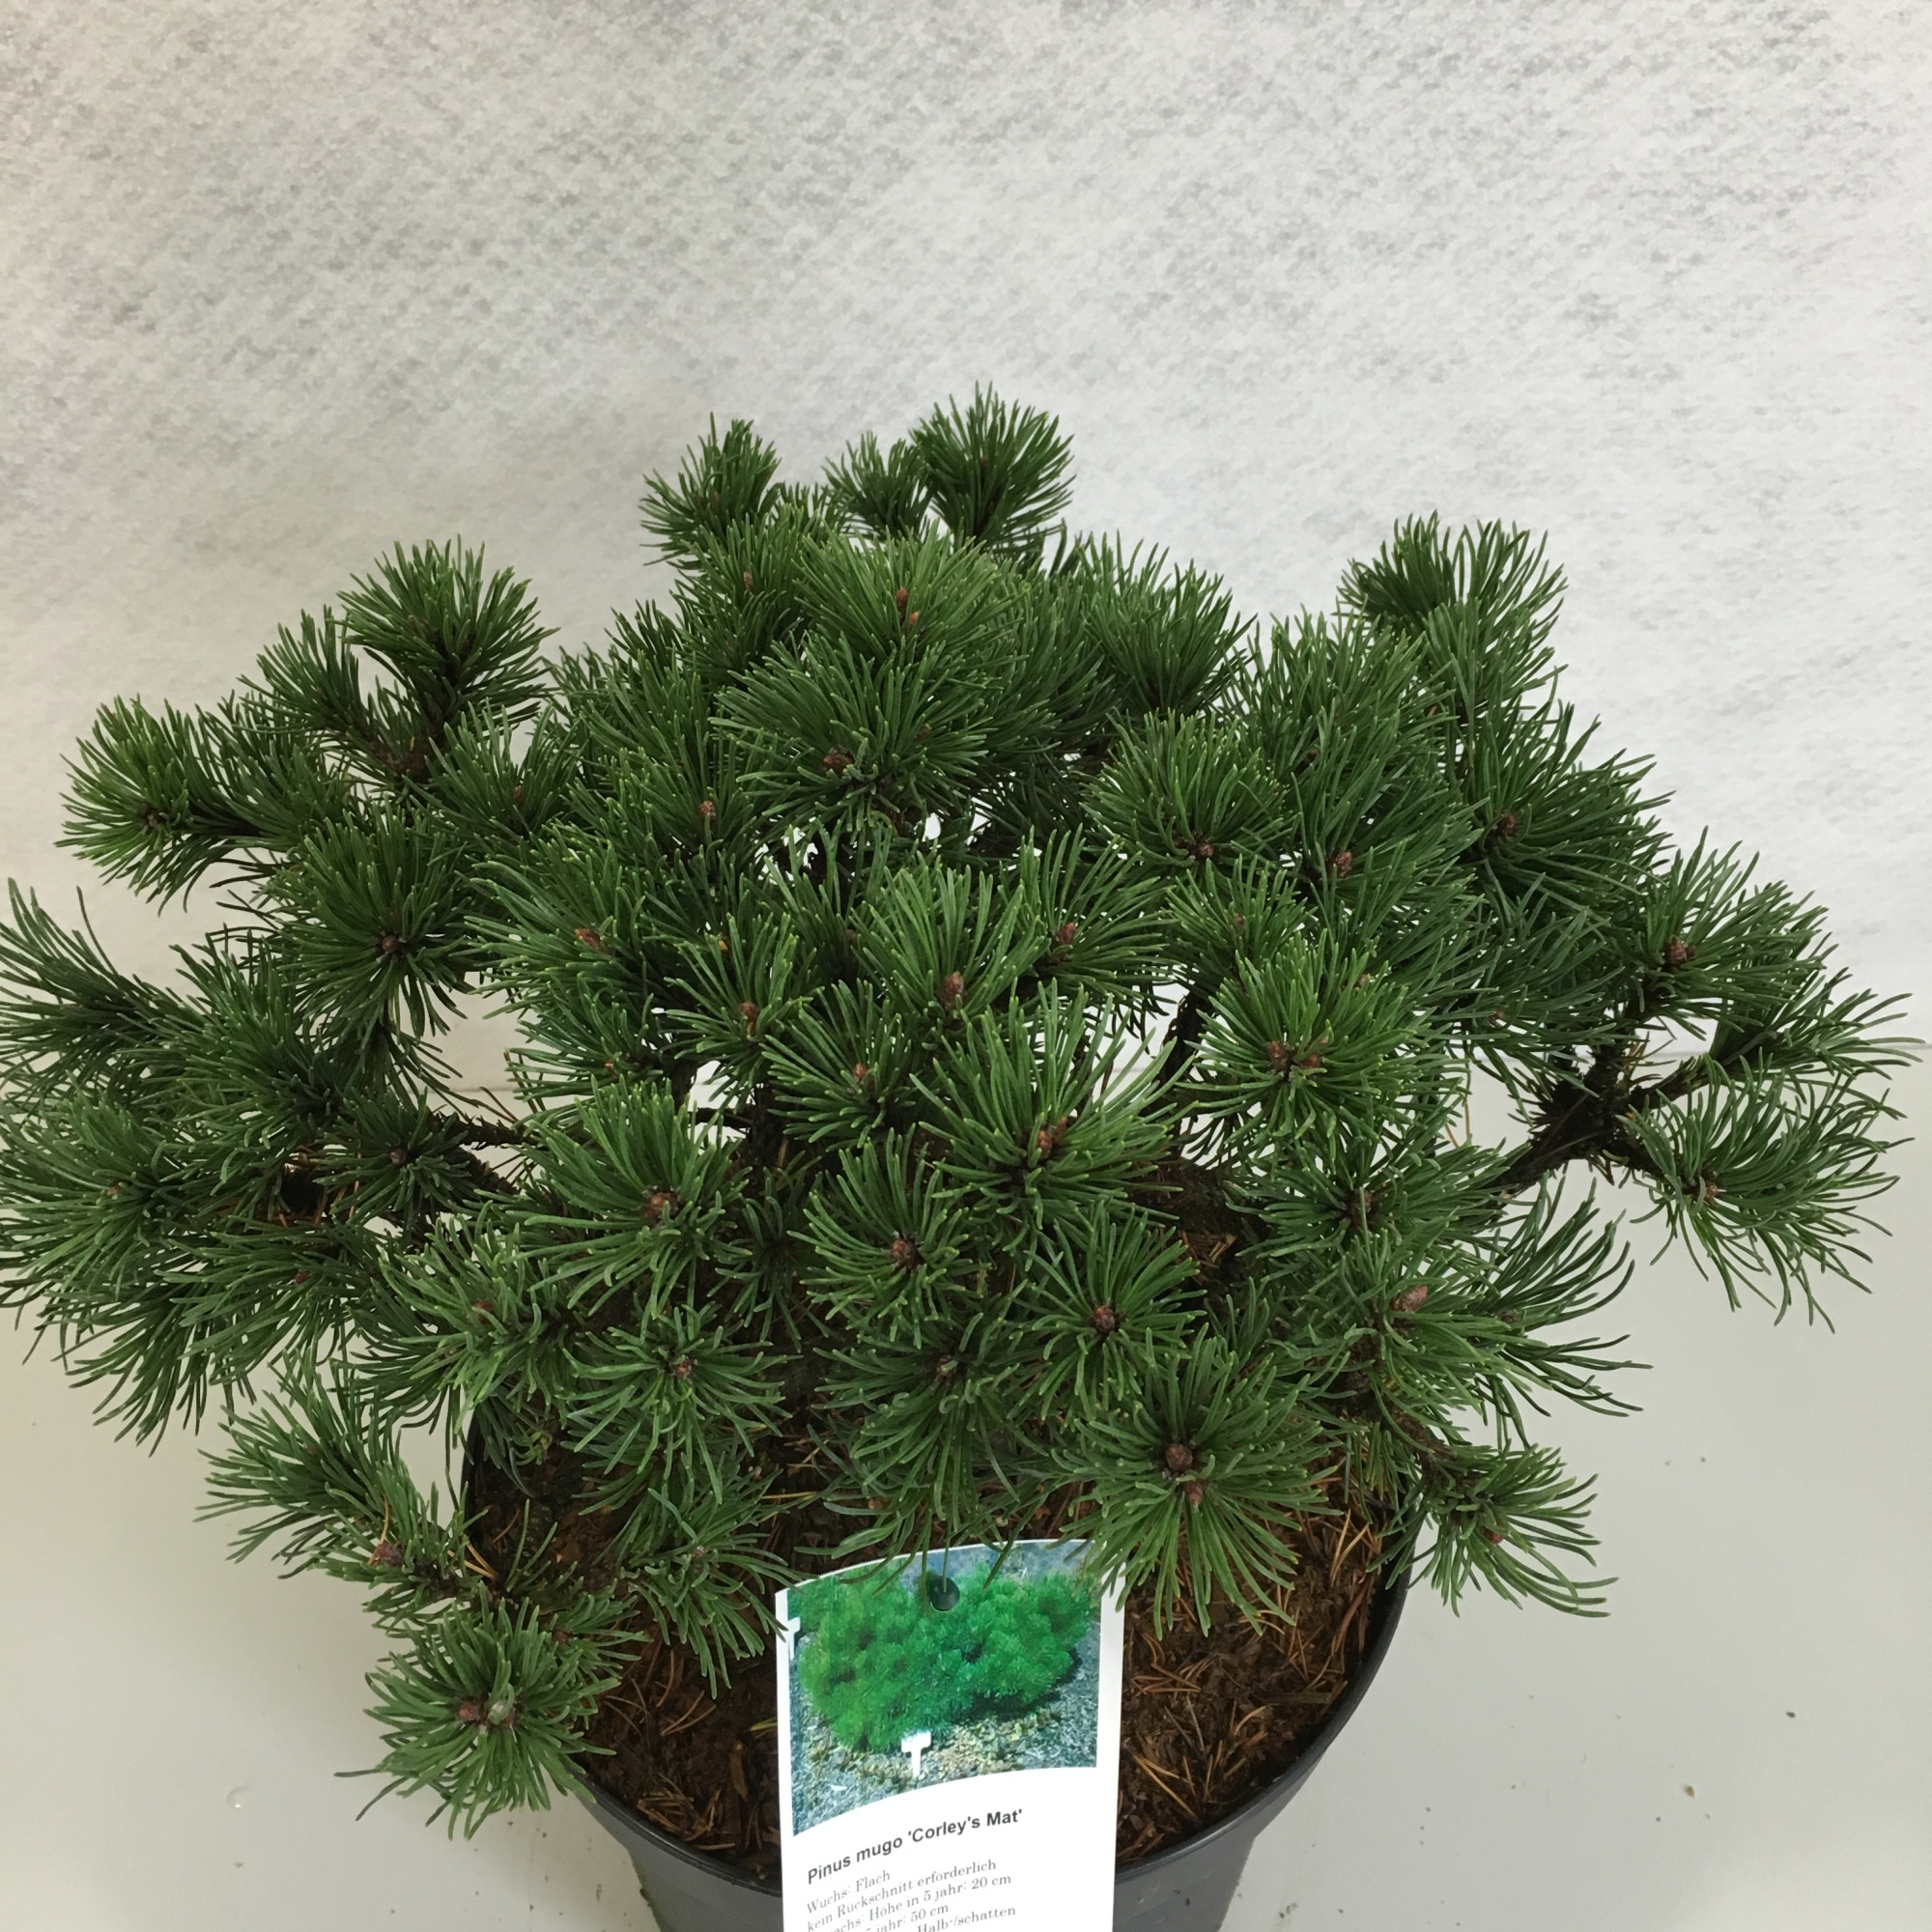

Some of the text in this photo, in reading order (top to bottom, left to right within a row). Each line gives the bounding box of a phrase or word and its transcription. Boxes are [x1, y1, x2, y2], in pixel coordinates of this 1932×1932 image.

[808, 1809, 1022, 1885] Pinus mugo 'Corley's Mat'
[807, 1870, 891, 1914] Wuchs: Flach
[808, 1914, 833, 1932] kein
[917, 1859, 996, 1887] erforderlich
[907, 1896, 919, 1908] in
[923, 1889, 931, 1902] 5
[934, 1882, 966, 1902] jahr:
[972, 1877, 988, 1889] 20
[991, 1875, 1011, 1886] cm
[910, 1908, 926, 1922] 50
[929, 1905, 949, 1917] cm
